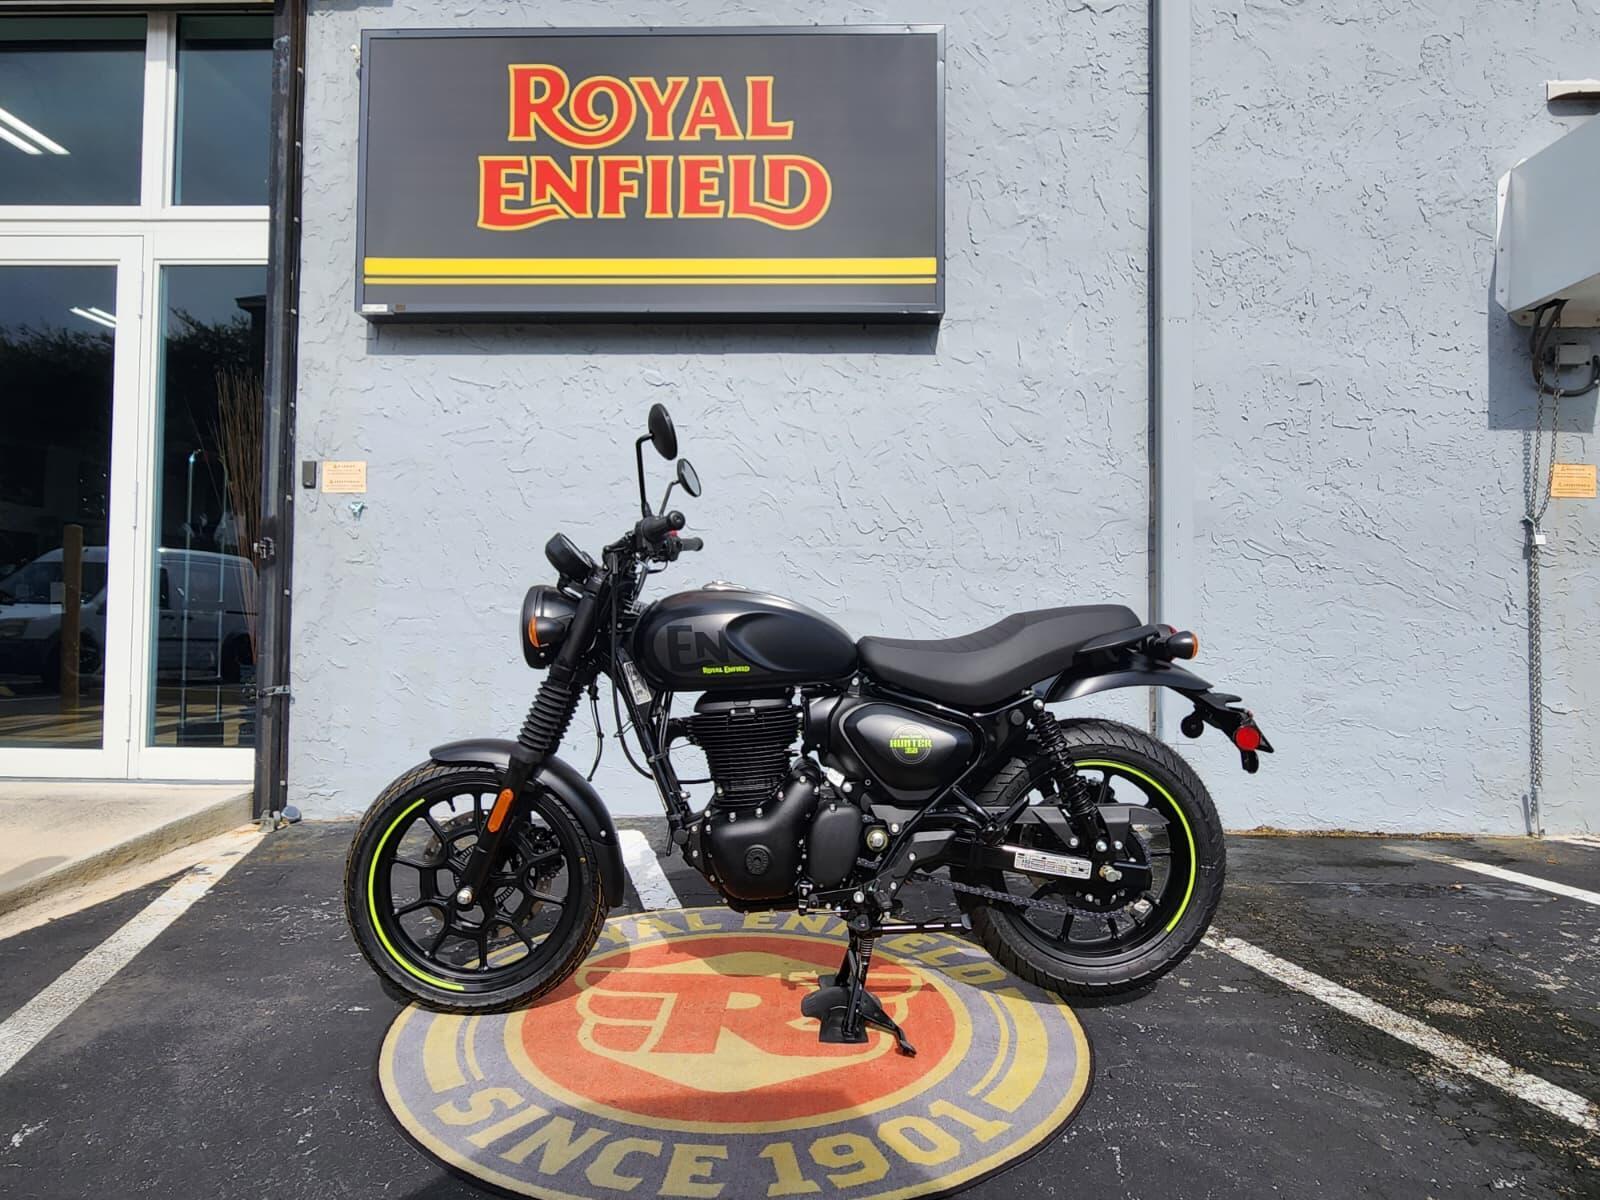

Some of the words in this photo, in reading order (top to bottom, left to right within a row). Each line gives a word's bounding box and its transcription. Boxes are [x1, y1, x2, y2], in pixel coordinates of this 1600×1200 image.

[507, 63, 794, 150] ROYAL
[477, 155, 833, 231] ENFIELD
[723, 665, 750, 674] ENFIELD
[889, 739, 932, 748] HUNTER
[592, 911, 722, 948] YAL
[741, 909, 1008, 986] ENELD
[432, 1087, 729, 1198] SINCE
[758, 1099, 1014, 1198] 1901
